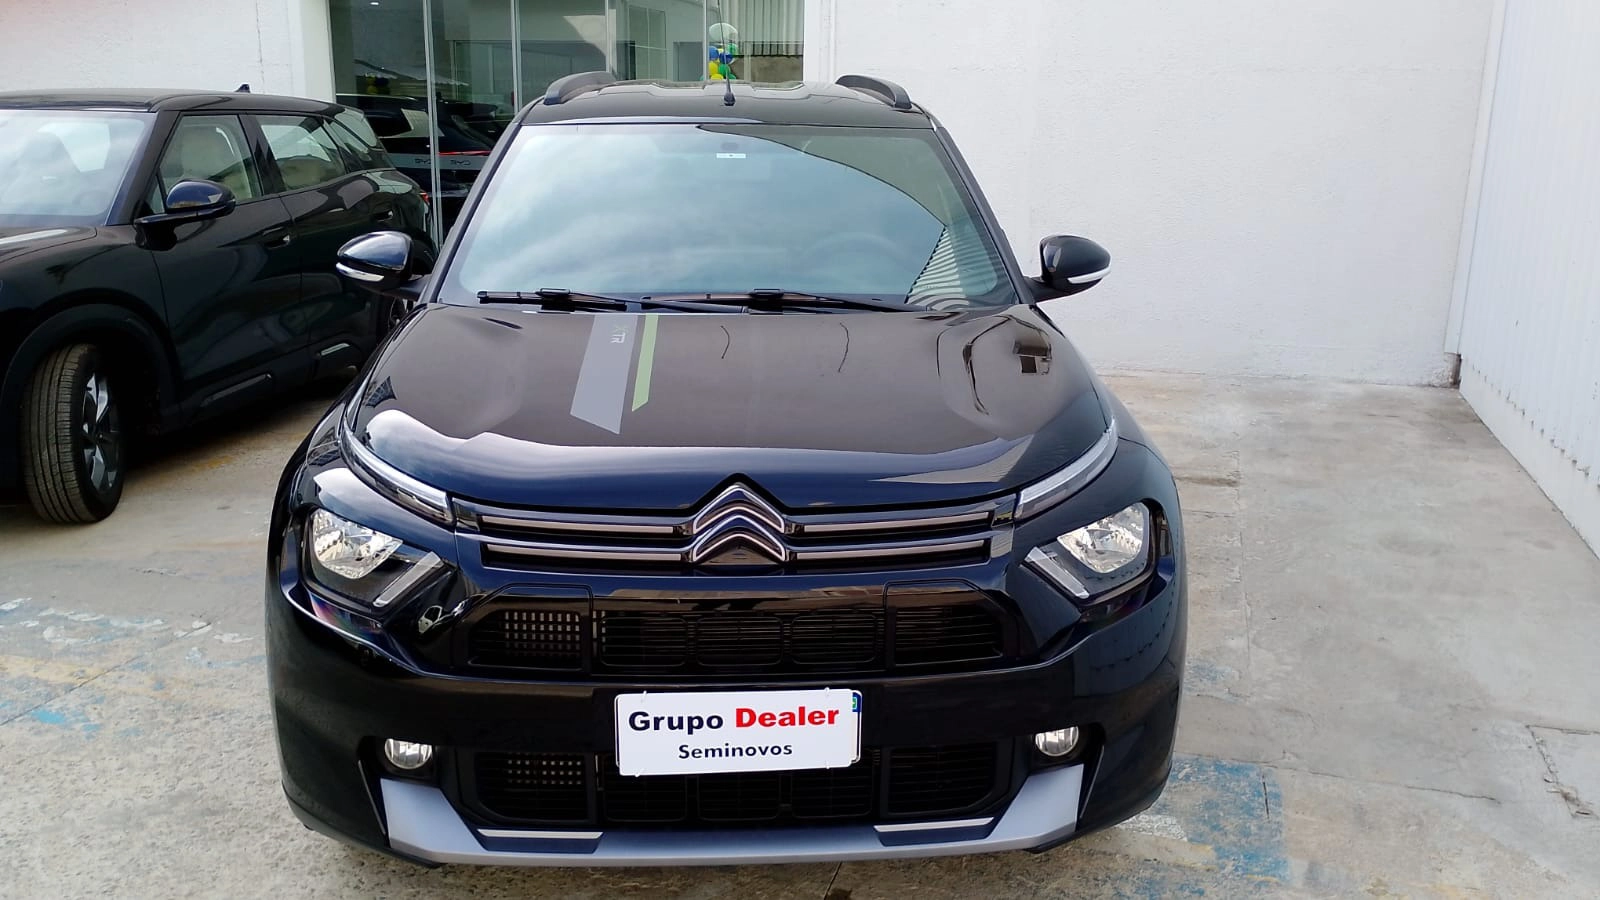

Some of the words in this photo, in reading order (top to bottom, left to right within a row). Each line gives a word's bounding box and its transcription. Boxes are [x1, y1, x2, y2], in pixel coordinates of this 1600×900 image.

[628, 711, 724, 735] Grupo
[735, 706, 839, 728] Dealer
[678, 743, 793, 760] Seminovos
